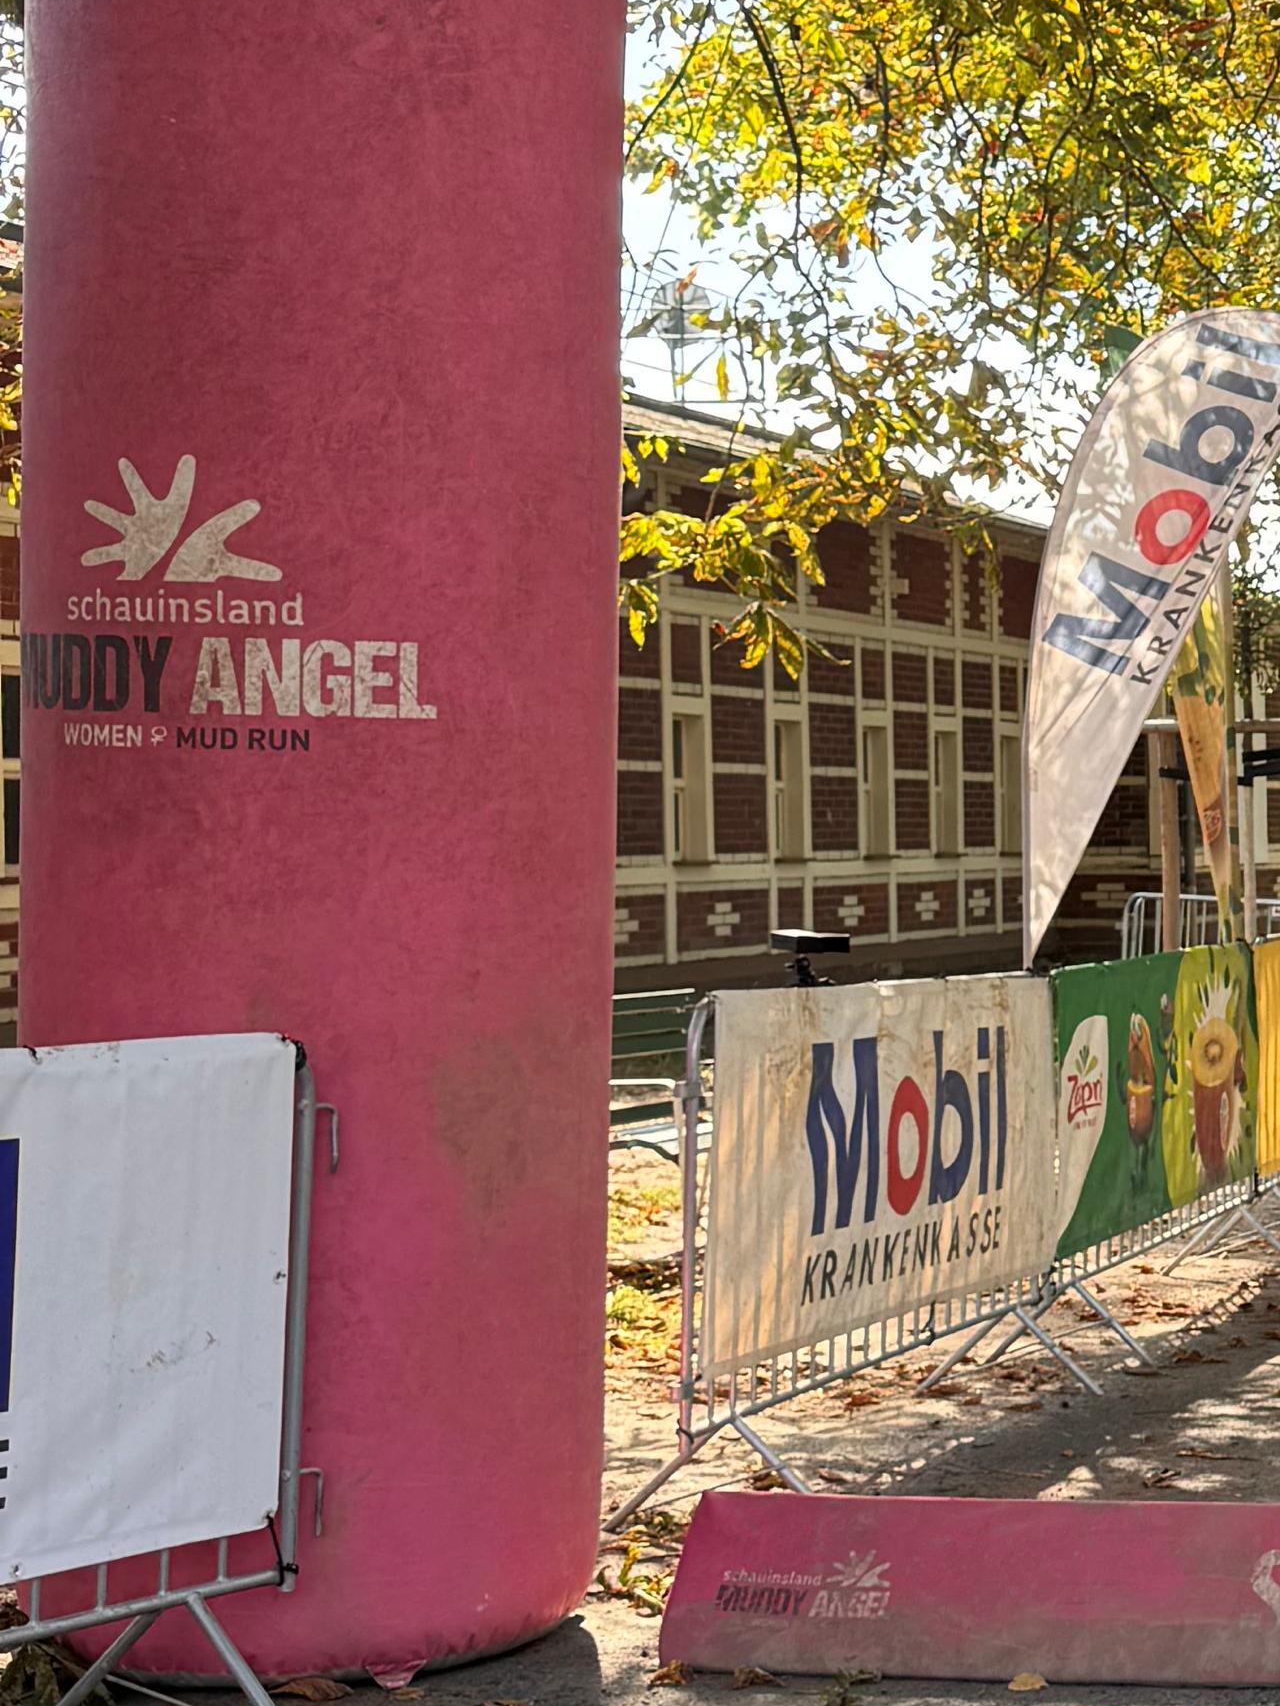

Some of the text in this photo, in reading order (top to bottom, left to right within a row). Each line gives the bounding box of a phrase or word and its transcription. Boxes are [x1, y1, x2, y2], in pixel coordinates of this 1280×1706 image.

[67, 588, 304, 626] schauinsland
[189, 637, 437, 719] ANGEL
[64, 724, 310, 752] WOMEN MUD RUN
[806, 1026, 1007, 1236] Mobil
[800, 1206, 1001, 1306] KRANKENKASSE
[723, 1568, 823, 1587] schauinsland
[715, 1584, 808, 1616] MUDDY
